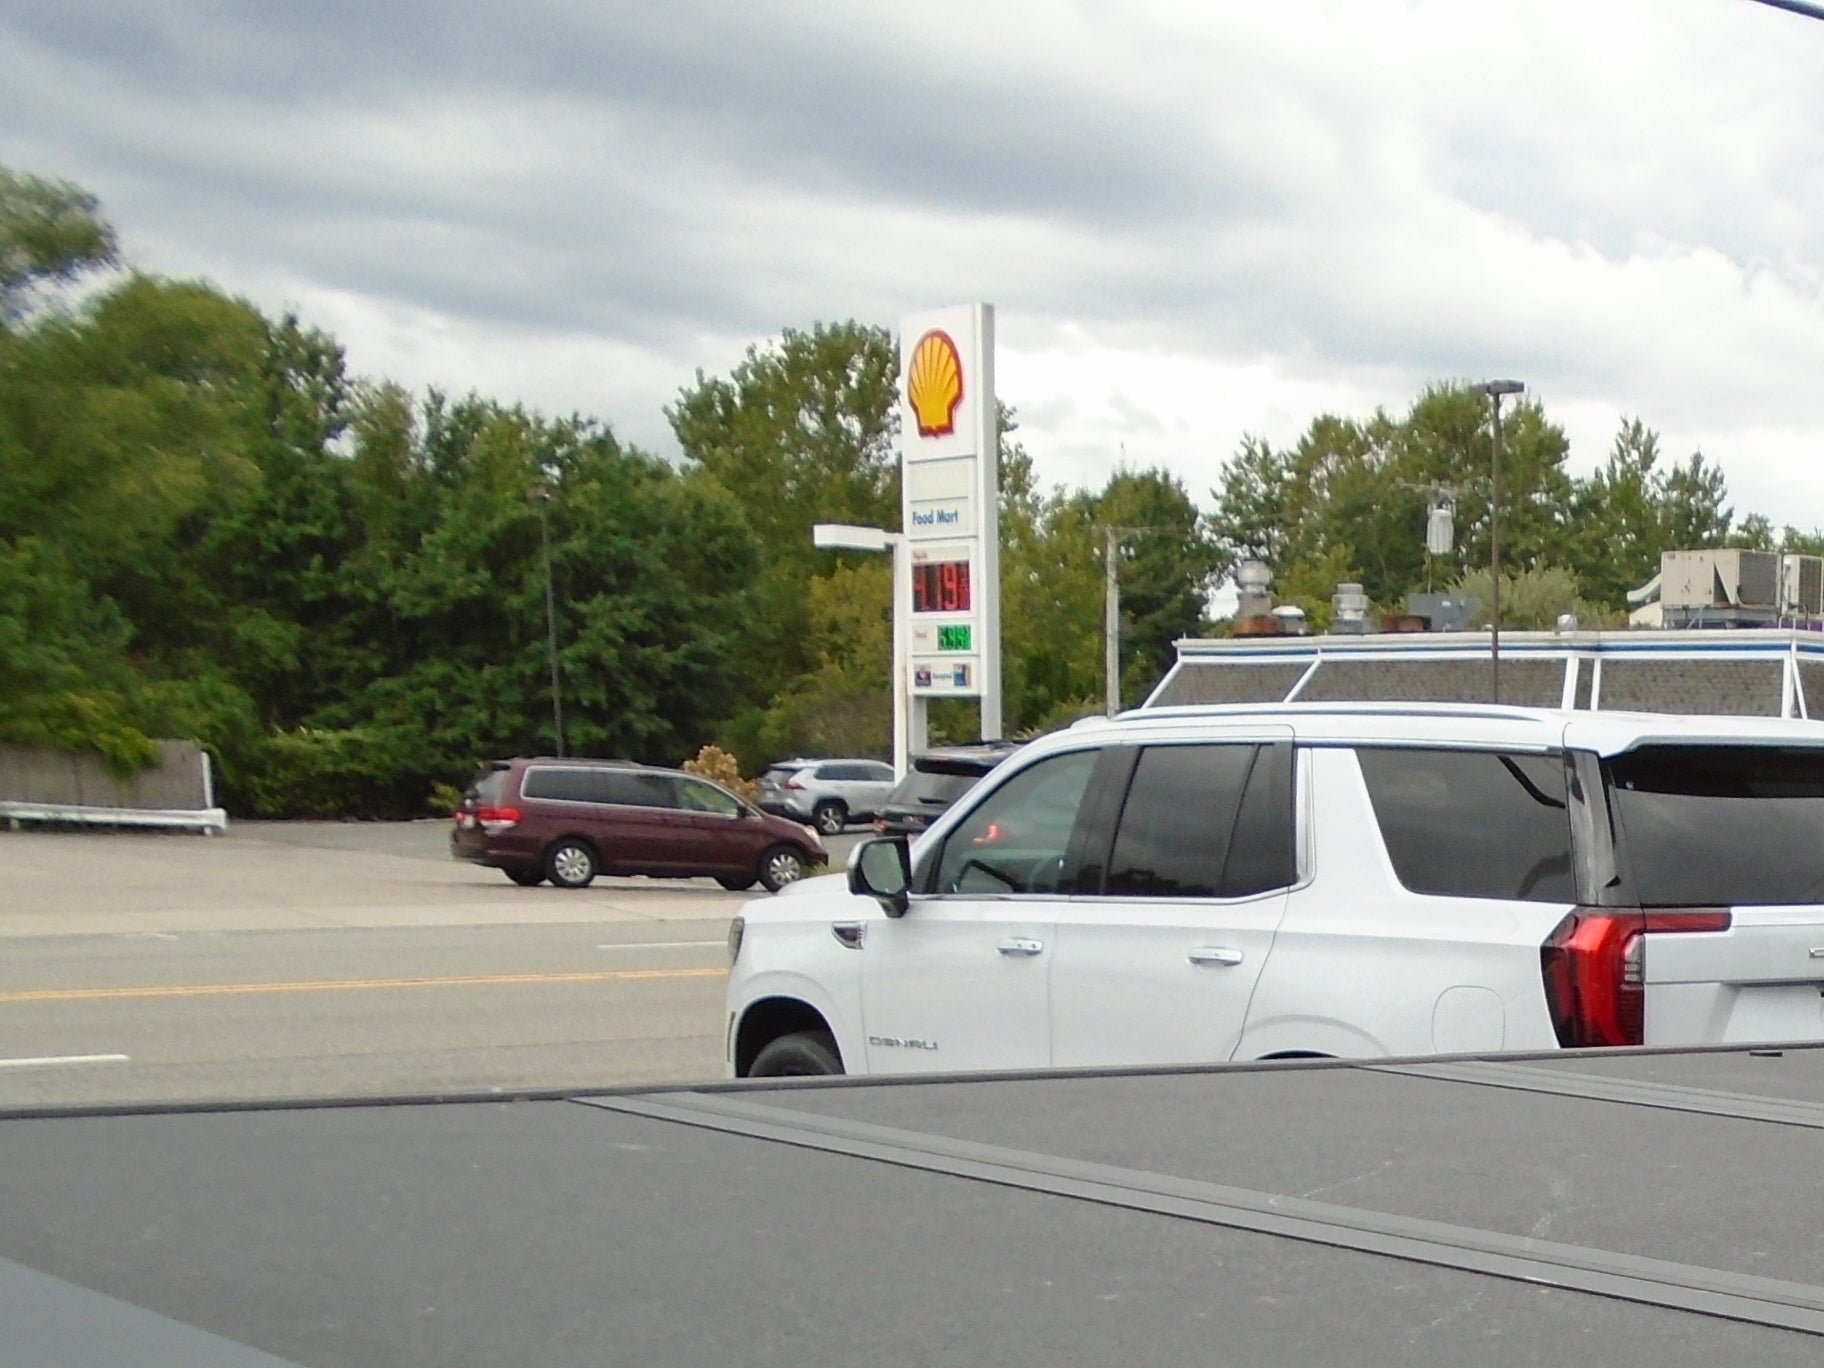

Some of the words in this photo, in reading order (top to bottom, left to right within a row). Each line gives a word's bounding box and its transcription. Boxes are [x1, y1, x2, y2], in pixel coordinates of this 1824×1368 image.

[912, 510, 934, 525] Food
[937, 508, 958, 523] Mart
[869, 1035, 938, 1050] DENALI
